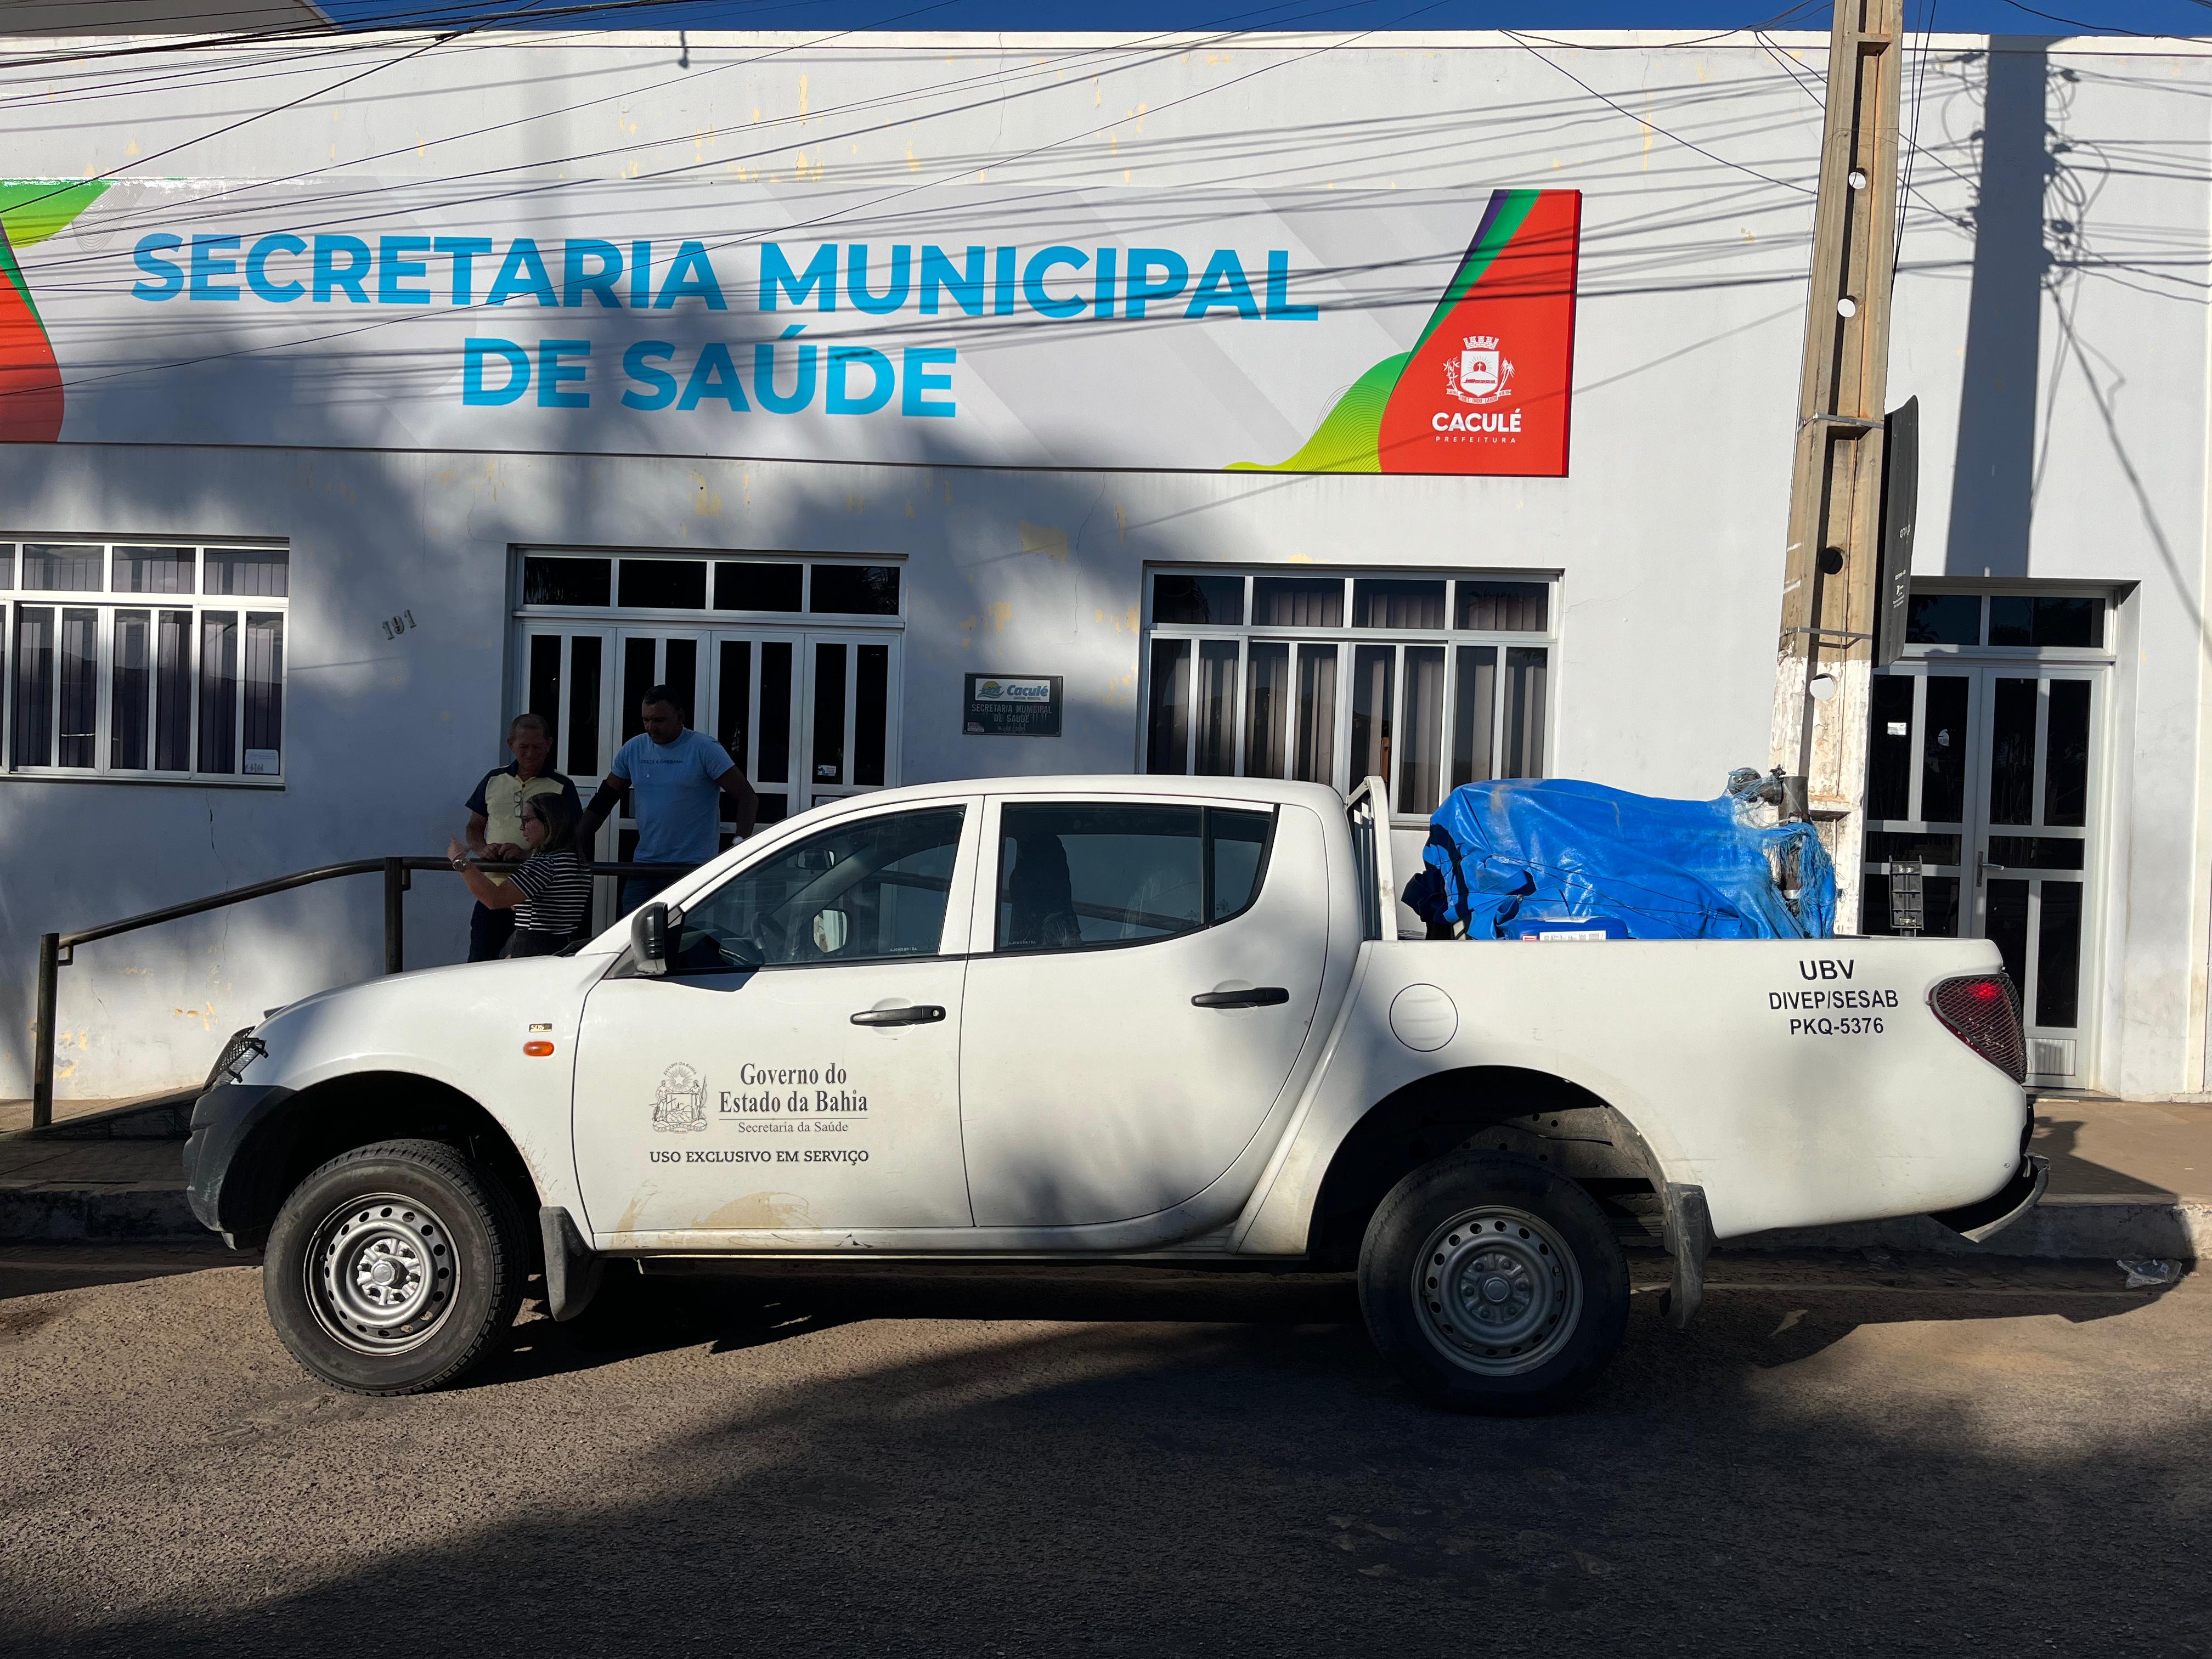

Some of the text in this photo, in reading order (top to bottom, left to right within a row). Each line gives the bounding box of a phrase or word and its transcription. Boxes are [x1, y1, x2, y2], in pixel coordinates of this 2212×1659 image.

[131, 233, 1319, 321] SECRETARIA MUNICIPAL
[462, 324, 957, 417] DE SAÚDE
[1432, 408, 1522, 432] CACULÉ
[382, 609, 417, 640] 191
[1007, 685, 1048, 697] Caculé
[972, 703, 1053, 714] SECRETARIA MUNICIPAL
[994, 714, 1003, 723] DE
[1799, 959, 1855, 980] UBV
[1769, 990, 1898, 1009] DIVEP/SESAB
[1790, 1017, 1884, 1036] PKQ-5376
[741, 1063, 847, 1085] Governo do
[719, 1090, 868, 1113] Estado da Bahia
[738, 1121, 848, 1133] Secretaria da Saúde
[650, 1150, 869, 1166] USO EXCLUSIVO EM SERVIÇO
